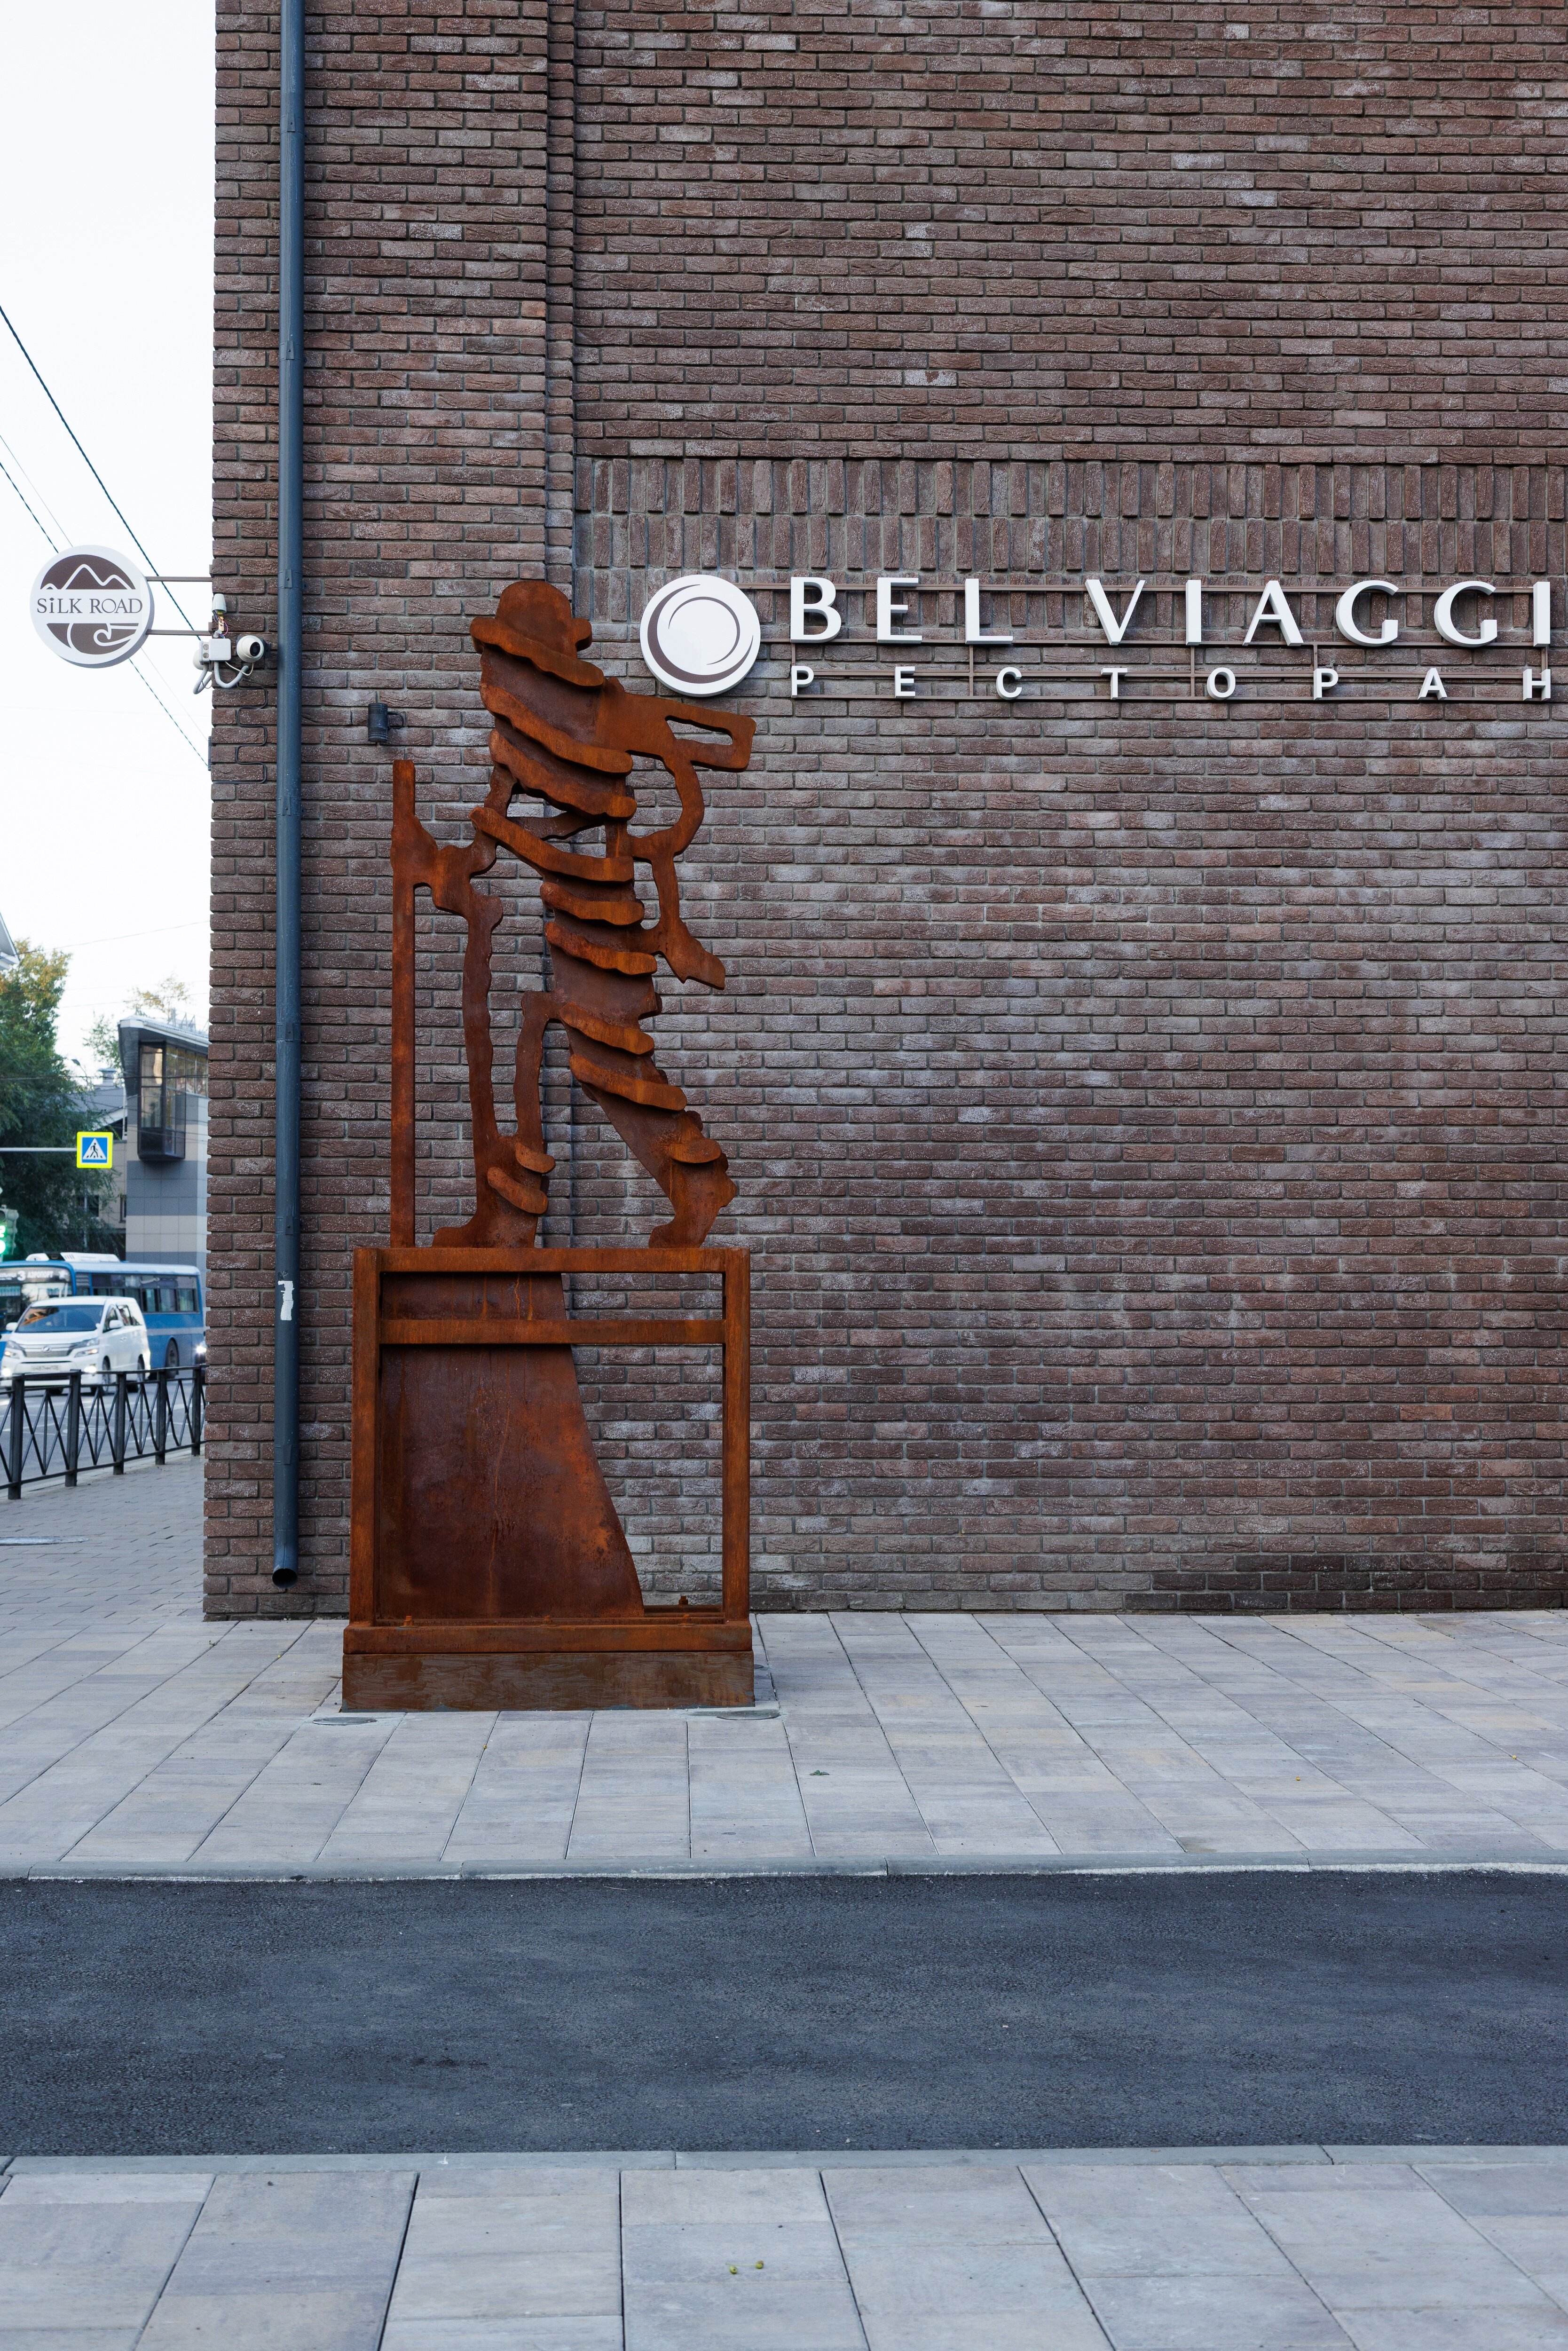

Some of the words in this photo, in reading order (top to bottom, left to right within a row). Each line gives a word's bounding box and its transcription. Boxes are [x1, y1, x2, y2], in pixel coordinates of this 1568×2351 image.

[89, 598, 143, 614] ROAD
[789, 576, 1013, 645] BEL
[1084, 579, 1551, 647] VIAGGI
[791, 665, 1551, 701] РЕСТОРАН
[17, 1270, 25, 1281] 3
